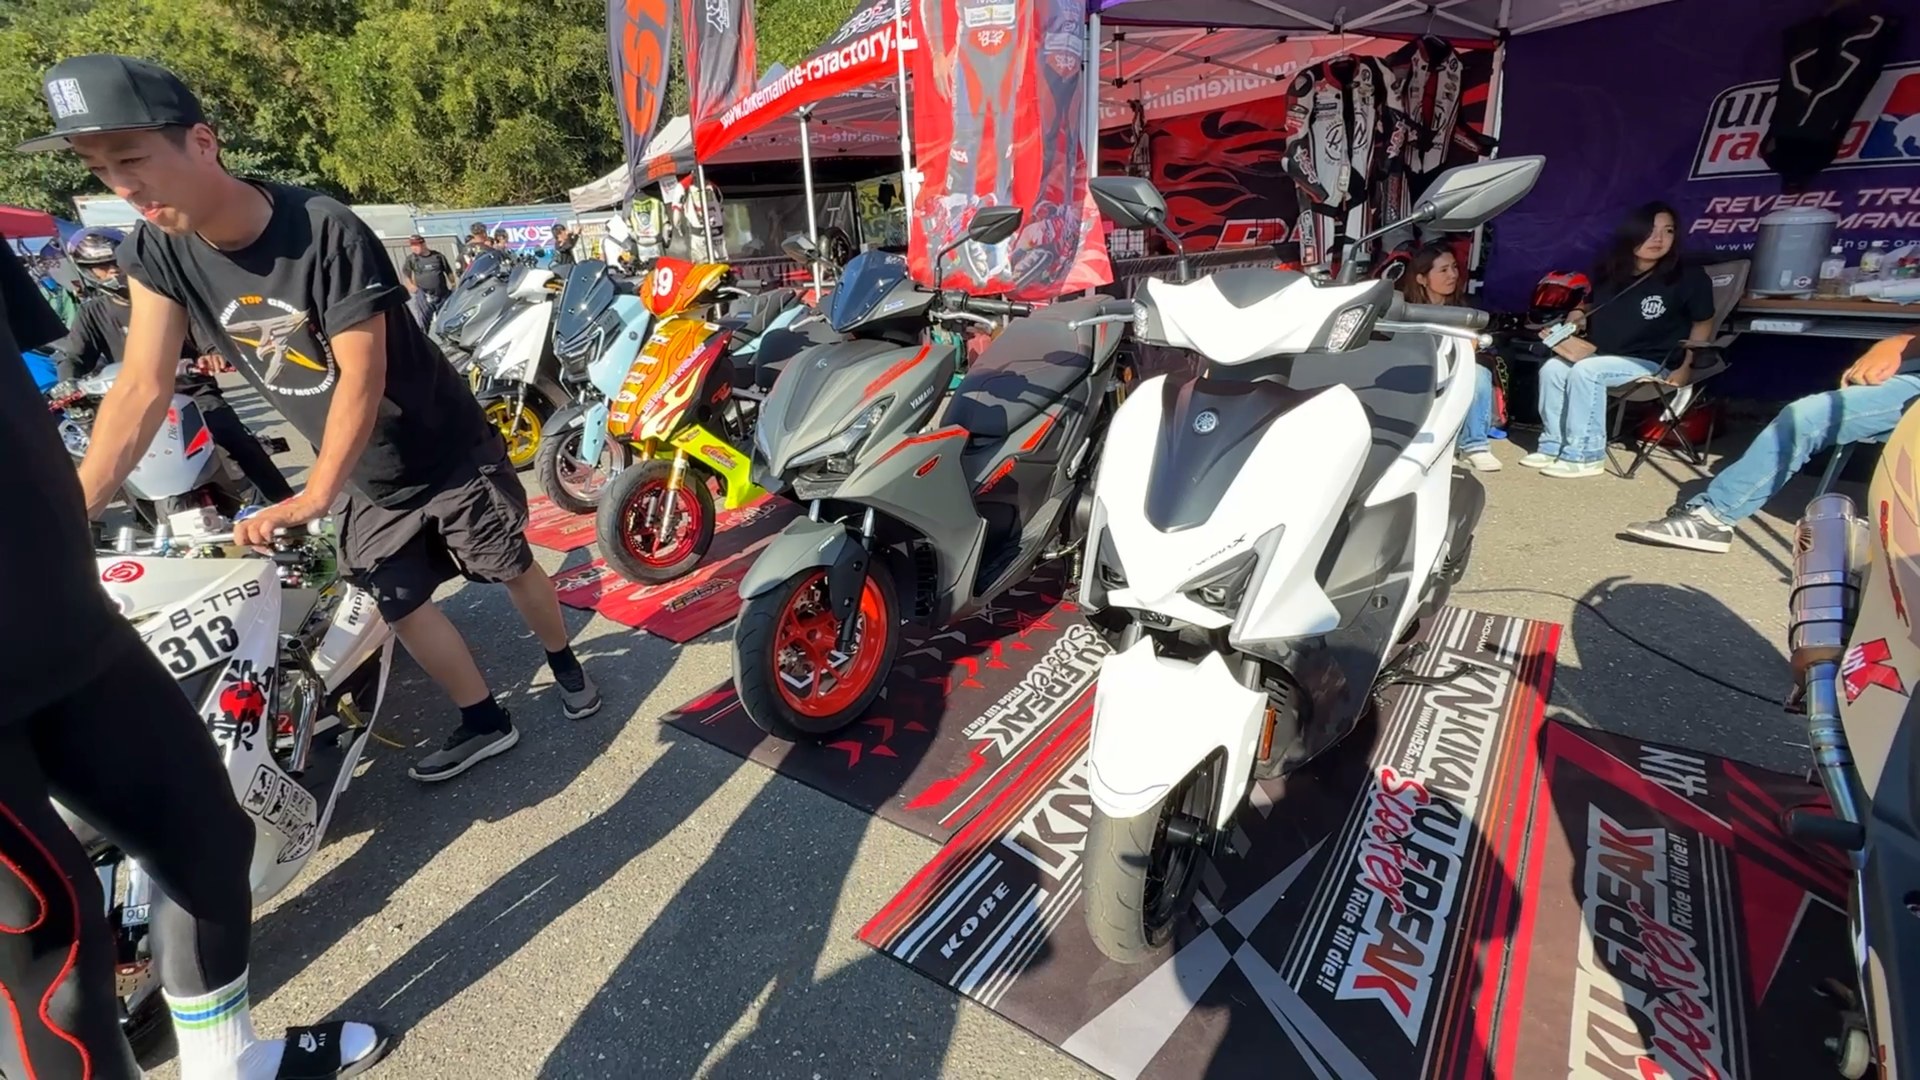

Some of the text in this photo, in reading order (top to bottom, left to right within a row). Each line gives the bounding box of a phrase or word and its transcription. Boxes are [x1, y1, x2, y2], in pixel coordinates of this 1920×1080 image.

[1705, 190, 1843, 214] REVEAL
[909, 384, 935, 410] YAMAHA
[169, 580, 261, 631] B-TAS
[158, 615, 240, 675] 313
[1474, 615, 1496, 653] YOKOHAMA
[1669, 863, 1690, 887] till
[939, 881, 1011, 960] KOBE
[1342, 888, 1369, 925] Ride
[1671, 888, 1693, 930] Ride
[1333, 926, 1353, 955] till
